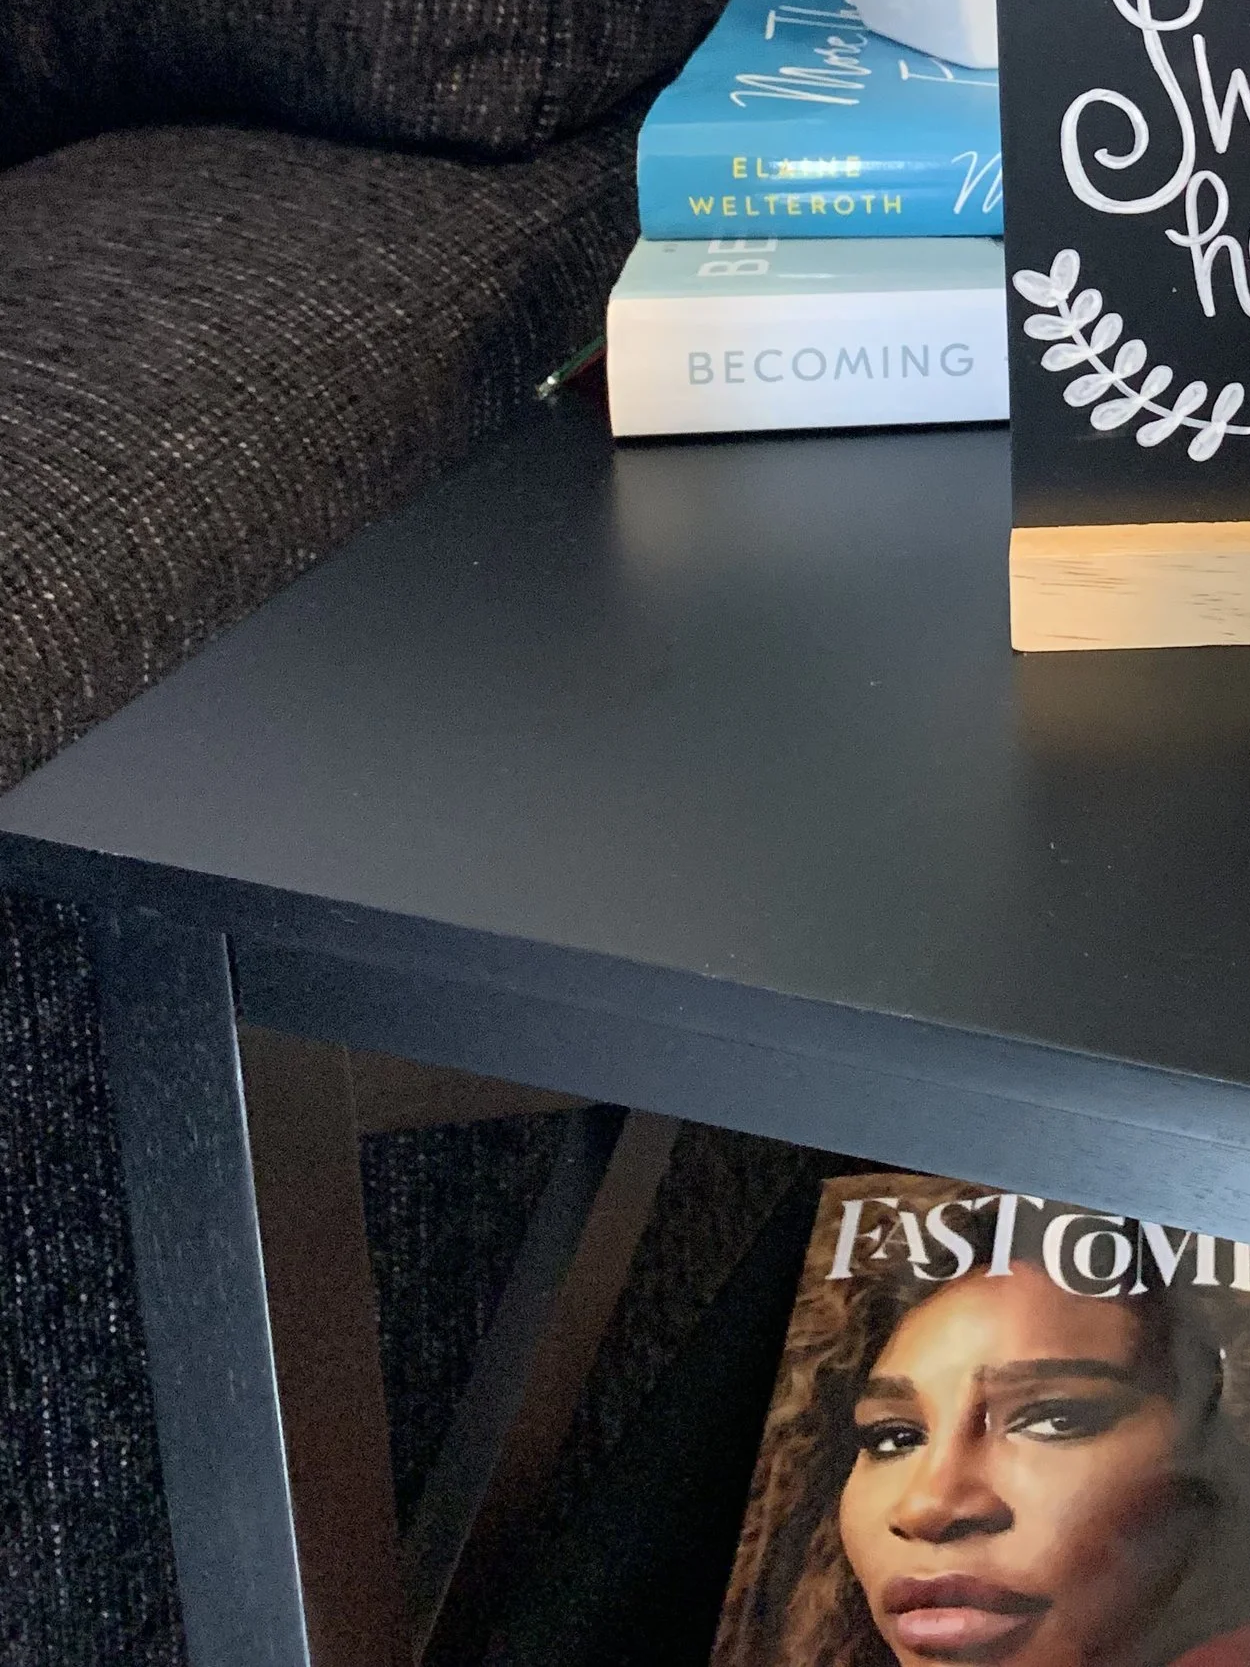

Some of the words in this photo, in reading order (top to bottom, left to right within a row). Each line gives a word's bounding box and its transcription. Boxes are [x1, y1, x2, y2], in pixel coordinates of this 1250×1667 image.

[731, 155, 862, 179] ELAINE
[688, 193, 903, 217] WELTEROTH
[687, 342, 975, 386] BECOMING
[825, 1194, 1045, 1281] FAST
